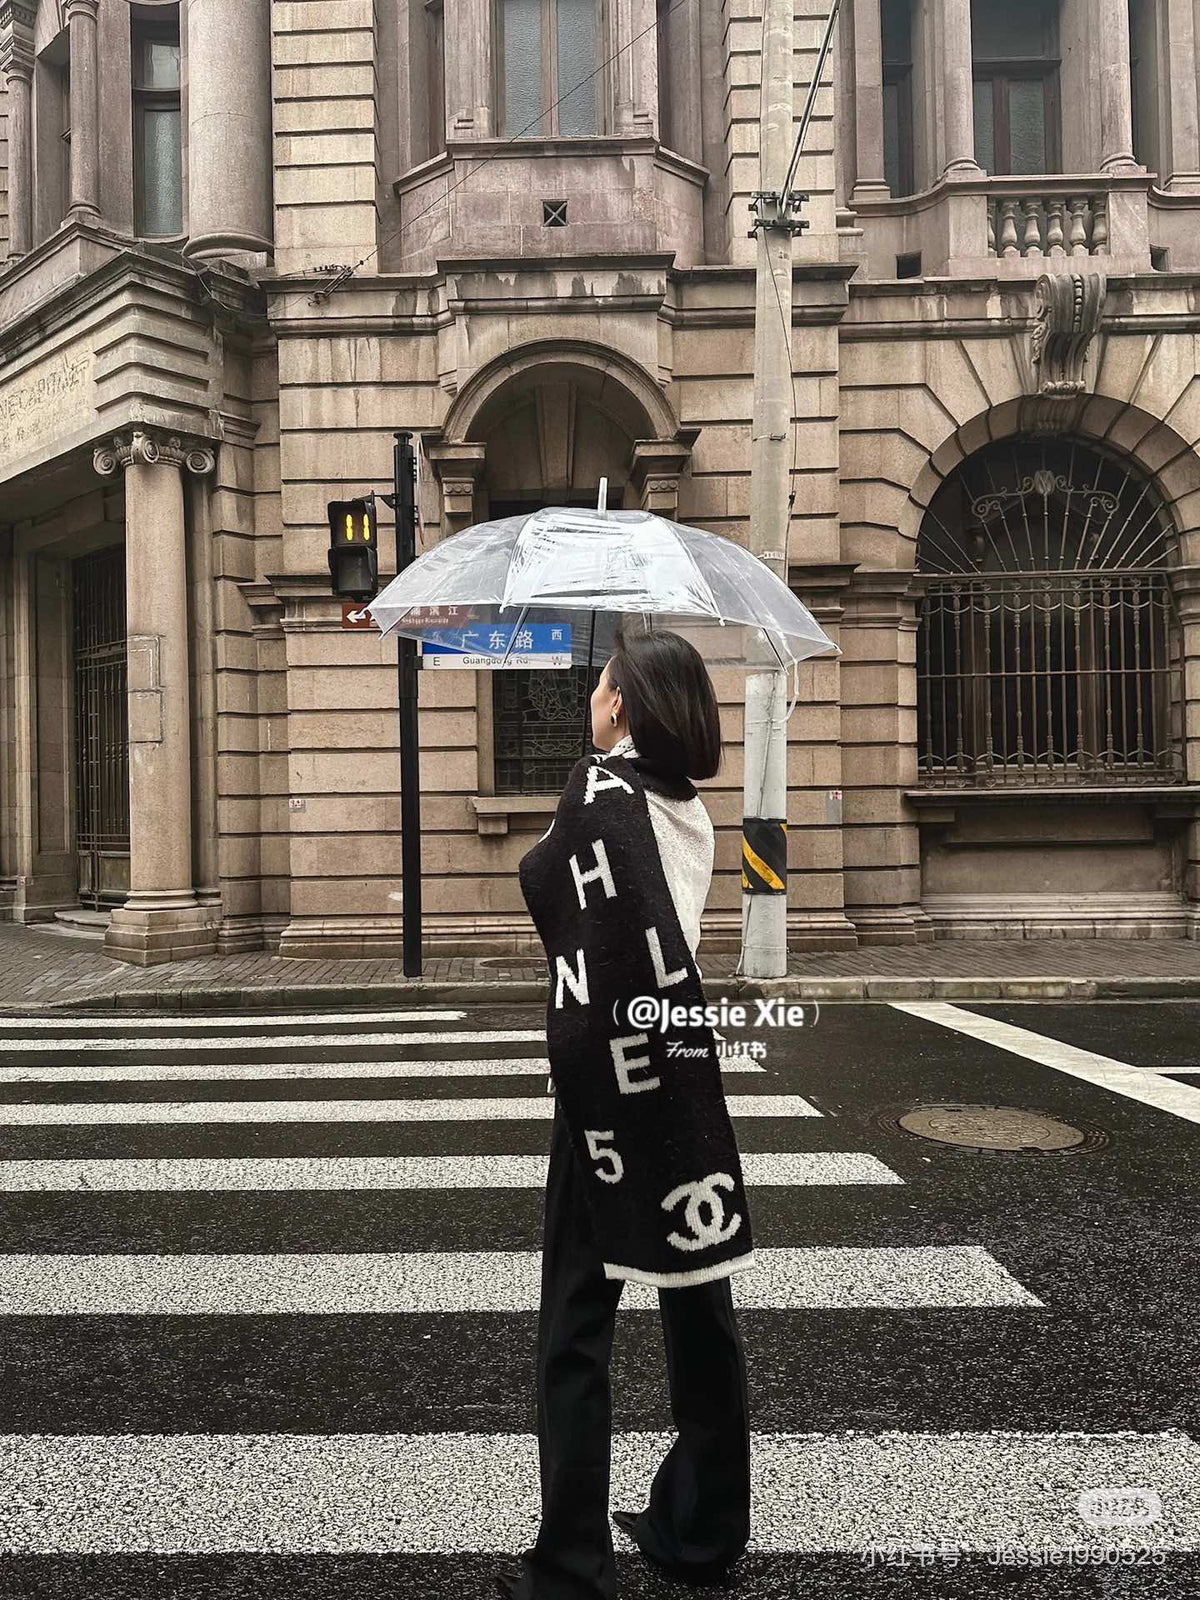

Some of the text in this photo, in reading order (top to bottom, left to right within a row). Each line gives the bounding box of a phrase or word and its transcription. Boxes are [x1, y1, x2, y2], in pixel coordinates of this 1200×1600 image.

[346, 514, 370, 541] 11
[461, 630, 534, 650] 广东路
[551, 629, 563, 641] 西
[433, 657, 440, 667] E
[462, 656, 513, 667] Guangdog
[583, 765, 635, 806] A
[569, 838, 618, 911] H
[645, 926, 689, 989] L
[555, 949, 590, 1010] N
[609, 1032, 661, 1095] E
[584, 1129, 625, 1185] 5
